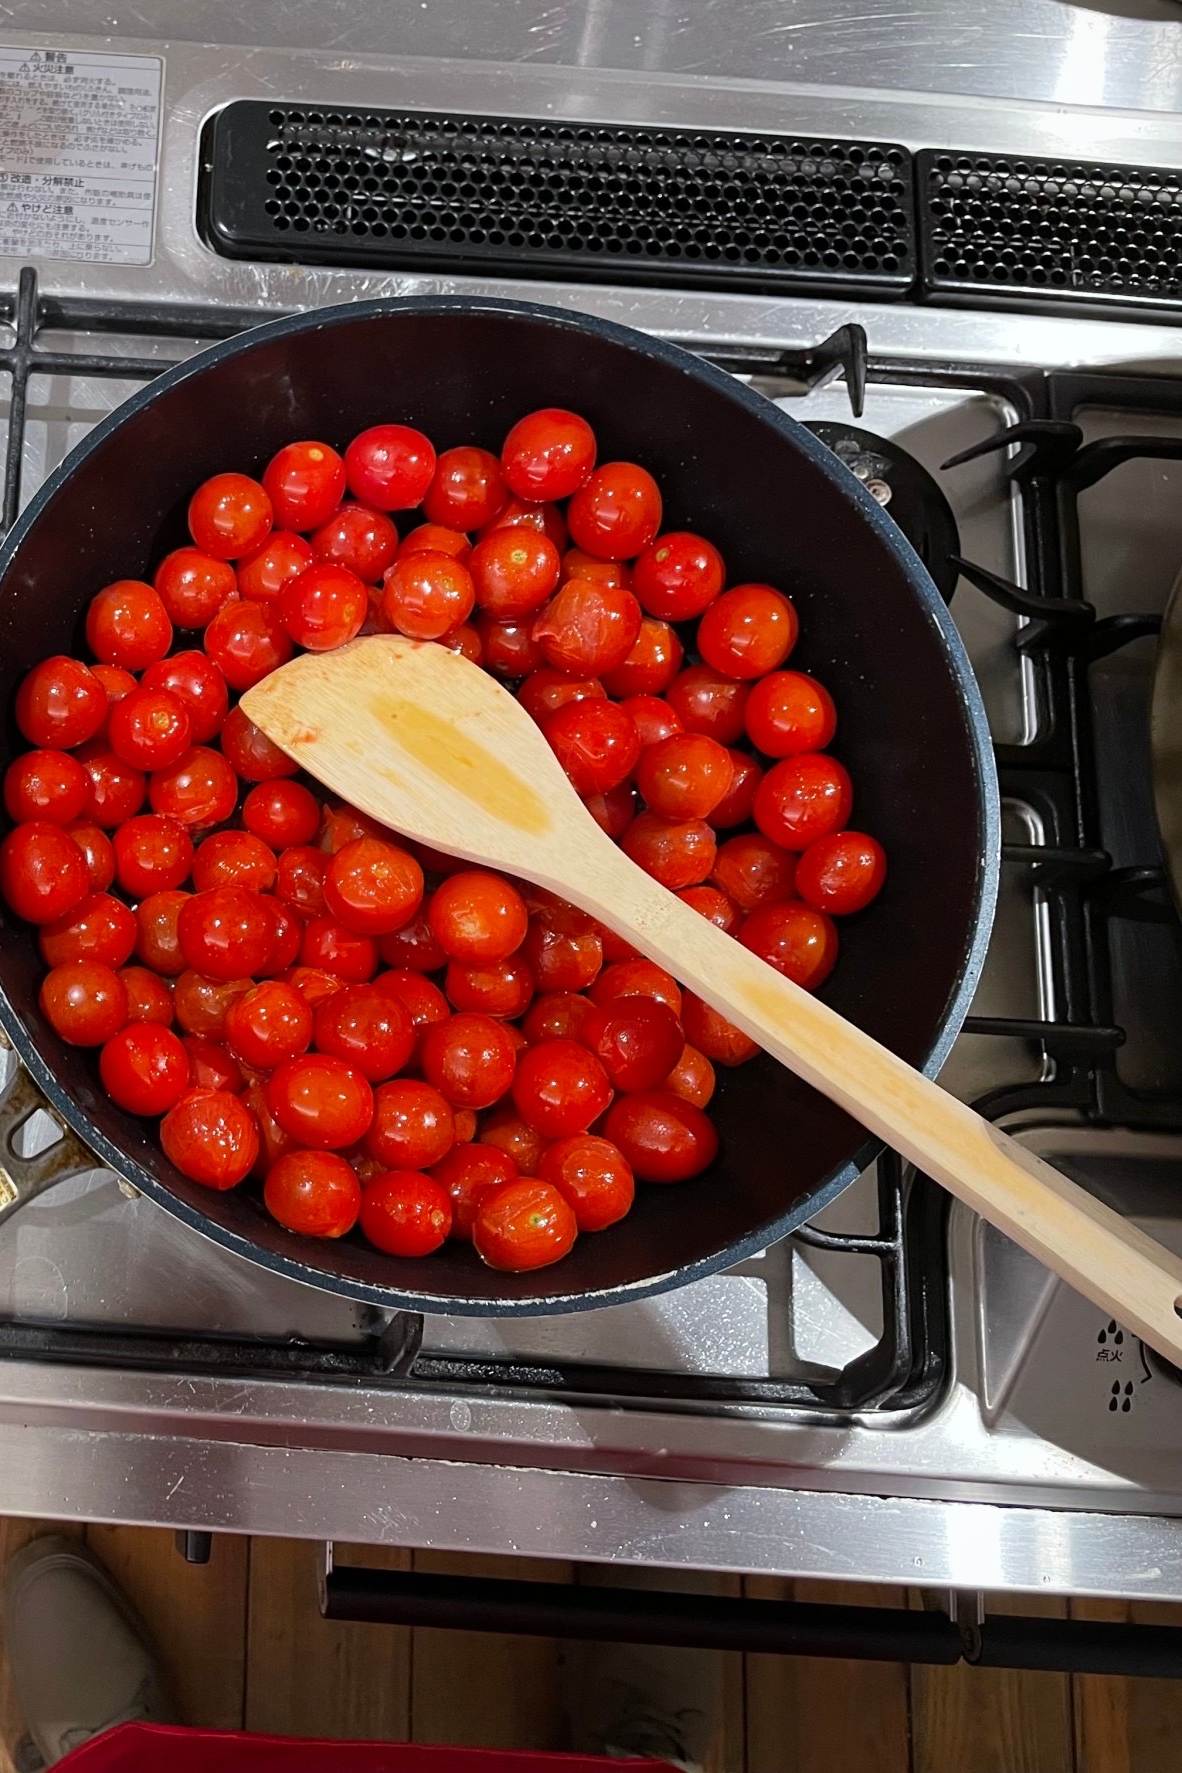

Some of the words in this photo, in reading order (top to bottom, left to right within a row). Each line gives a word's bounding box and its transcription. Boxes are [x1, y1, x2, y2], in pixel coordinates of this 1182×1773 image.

[10, 173, 84, 187] 改造・分解禁止
[21, 203, 74, 215] やけど注意
[1096, 1349, 1124, 1363] 点火
